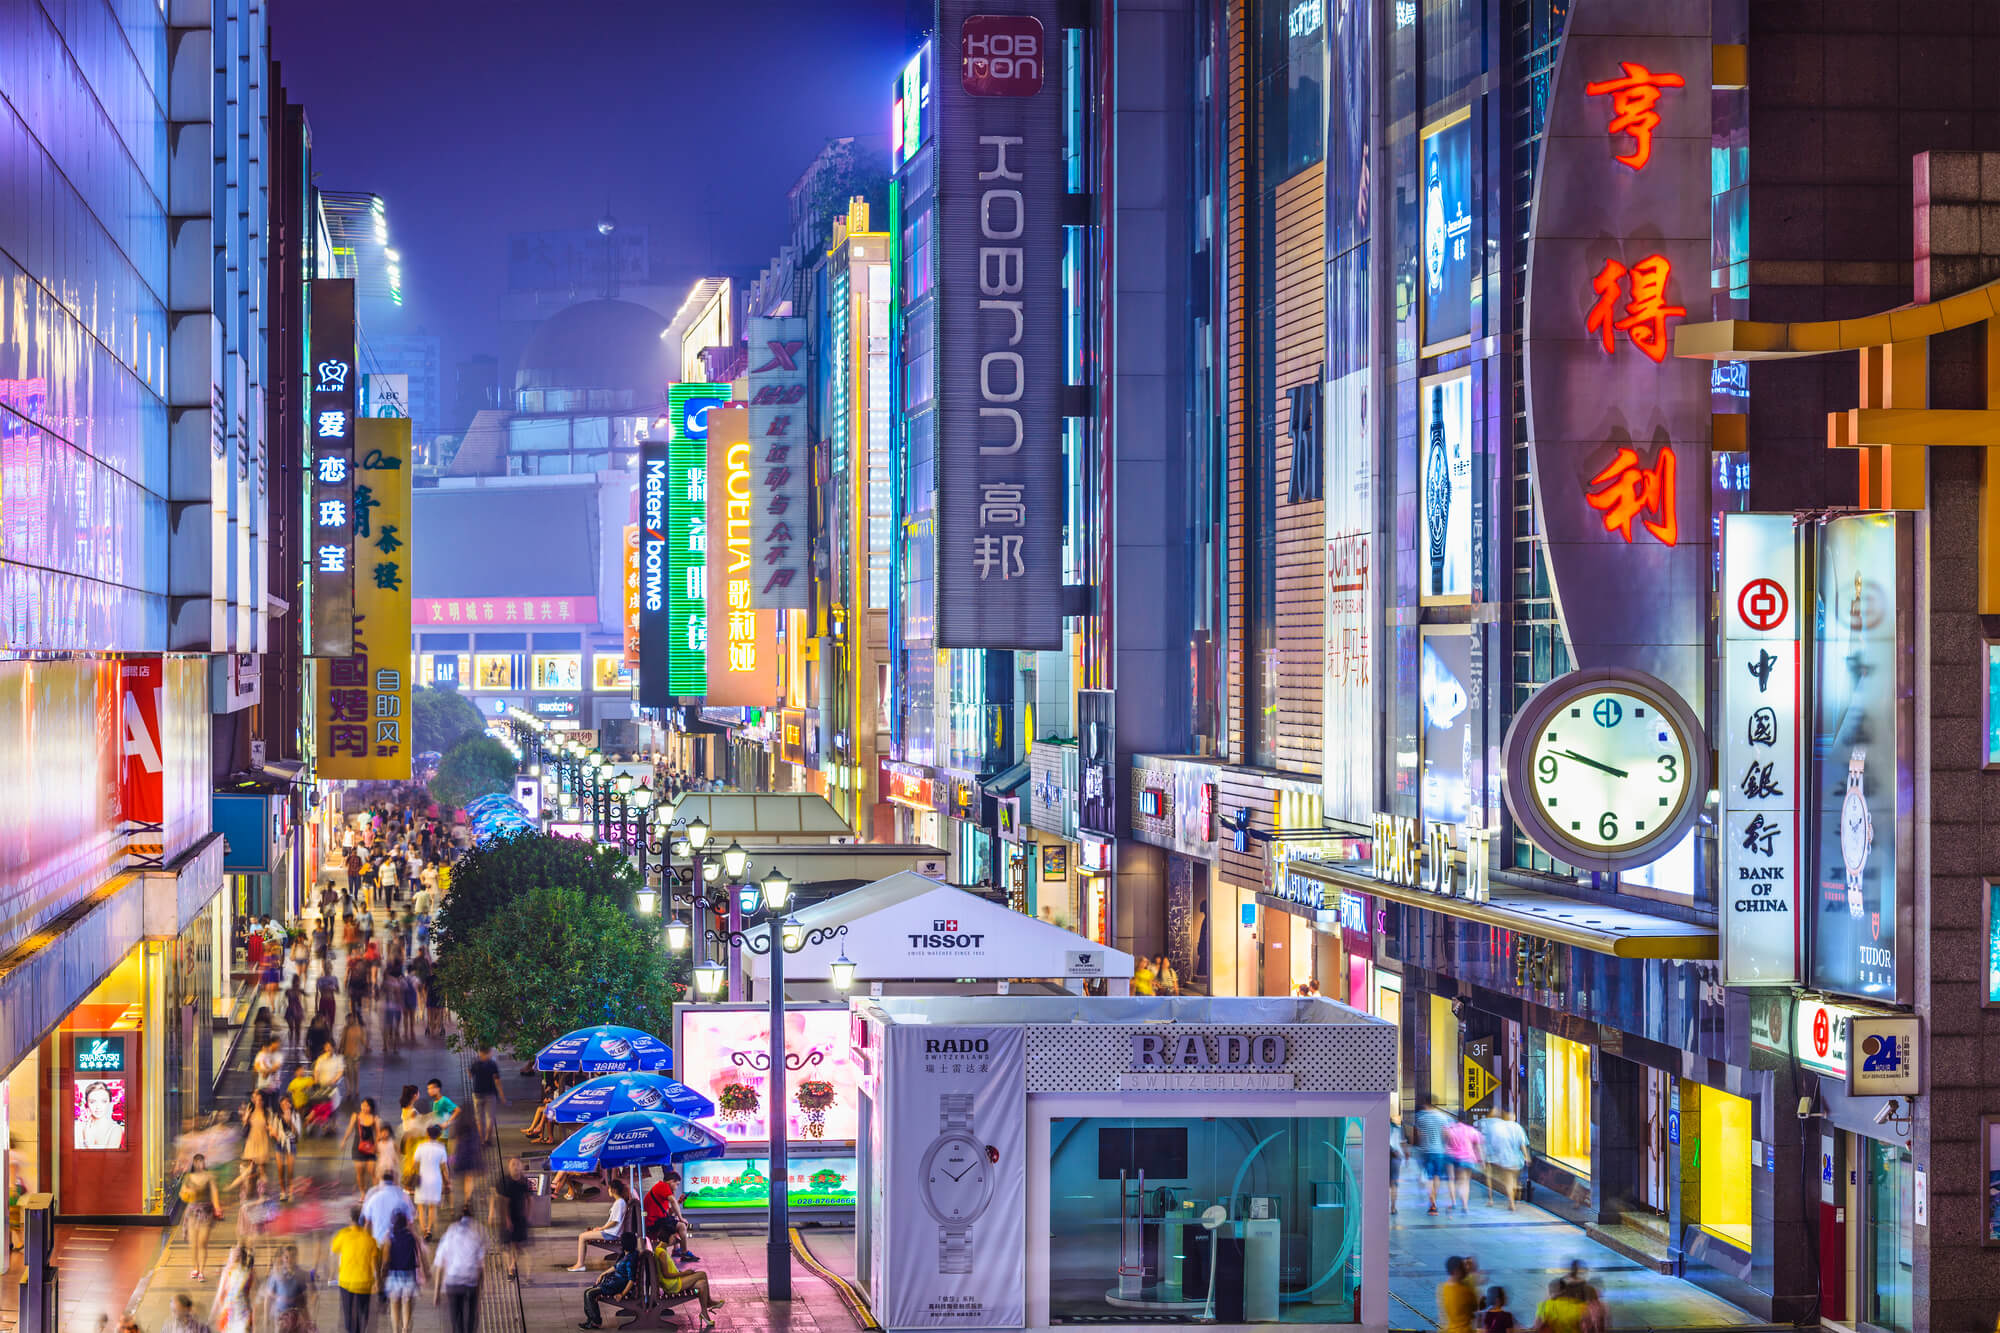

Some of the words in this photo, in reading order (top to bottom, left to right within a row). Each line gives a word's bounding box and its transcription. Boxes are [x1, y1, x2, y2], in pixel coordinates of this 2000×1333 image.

[1586, 62, 1686, 547] 亨得利
[318, 411, 346, 573] 爱恋珠宝
[973, 482, 1026, 581] 高邦
[432, 602, 494, 621] 文明城市
[437, 663, 454, 681] GAP
[376, 669, 400, 743] 自助风
[376, 745, 399, 757] 2F
[1740, 648, 1784, 858] 中國銀行
[1538, 756, 1559, 784] 9
[1657, 754, 1678, 783] 3
[1598, 812, 1619, 840] 6
[1739, 866, 1785, 880] BANK
[1751, 883, 1772, 896] OF
[1734, 899, 1788, 912] CHINA
[908, 934, 985, 948] TISSOT
[1860, 946, 1891, 968] TUDOR
[926, 1039, 989, 1053] RADO
[1131, 1034, 1288, 1066] RADO
[1473, 1044, 1488, 1056] 3F
[1863, 1034, 1901, 1072] 24
[925, 1063, 989, 1073] 瑞士雷达表
[1131, 1075, 1287, 1088] SWITZERLAND
[613, 1130, 649, 1139] 水动乐
